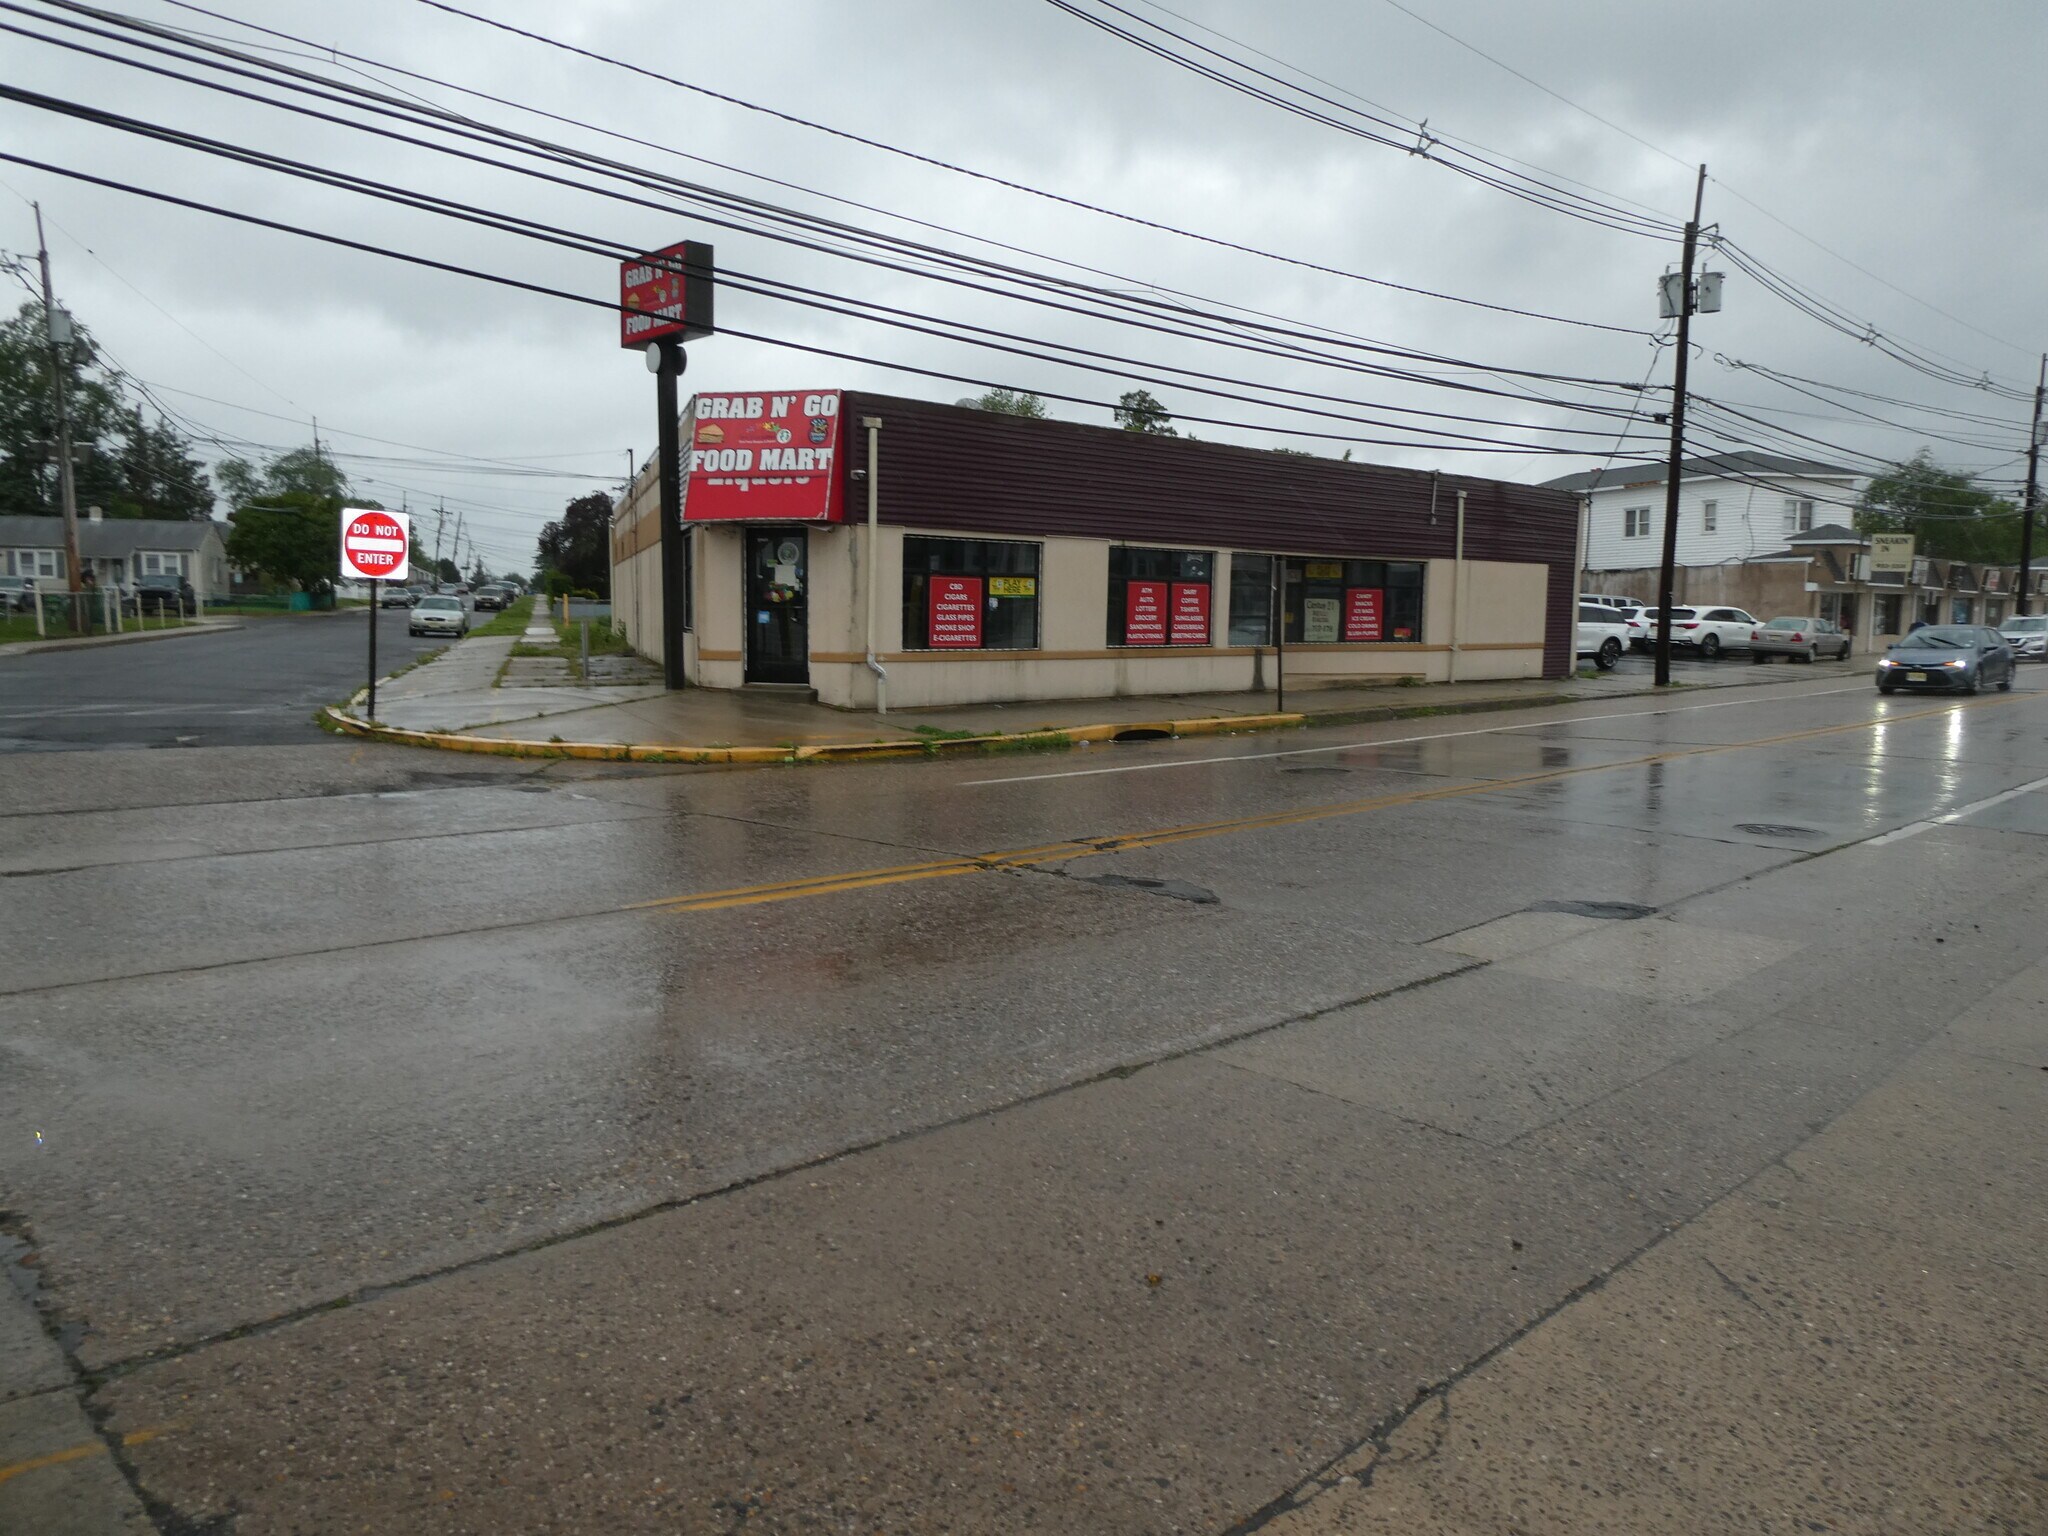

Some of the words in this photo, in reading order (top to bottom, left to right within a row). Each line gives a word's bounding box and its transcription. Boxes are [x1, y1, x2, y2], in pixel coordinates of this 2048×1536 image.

[625, 266, 652, 288] GRAB
[626, 314, 652, 335] FOOD
[653, 303, 682, 328] MART
[695, 397, 764, 420] GRAB
[770, 395, 797, 418] N'
[804, 394, 839, 417] GO
[690, 448, 754, 472] FOOD
[759, 447, 833, 471] MART
[353, 523, 370, 535] DO
[375, 525, 399, 536] NOT
[356, 552, 394, 565] ENTER
[944, 593, 968, 601] CIGARS
[935, 624, 956, 632] SMOKE
[958, 624, 975, 632] SHOP
[933, 634, 977, 642] E-CIGARETTES
